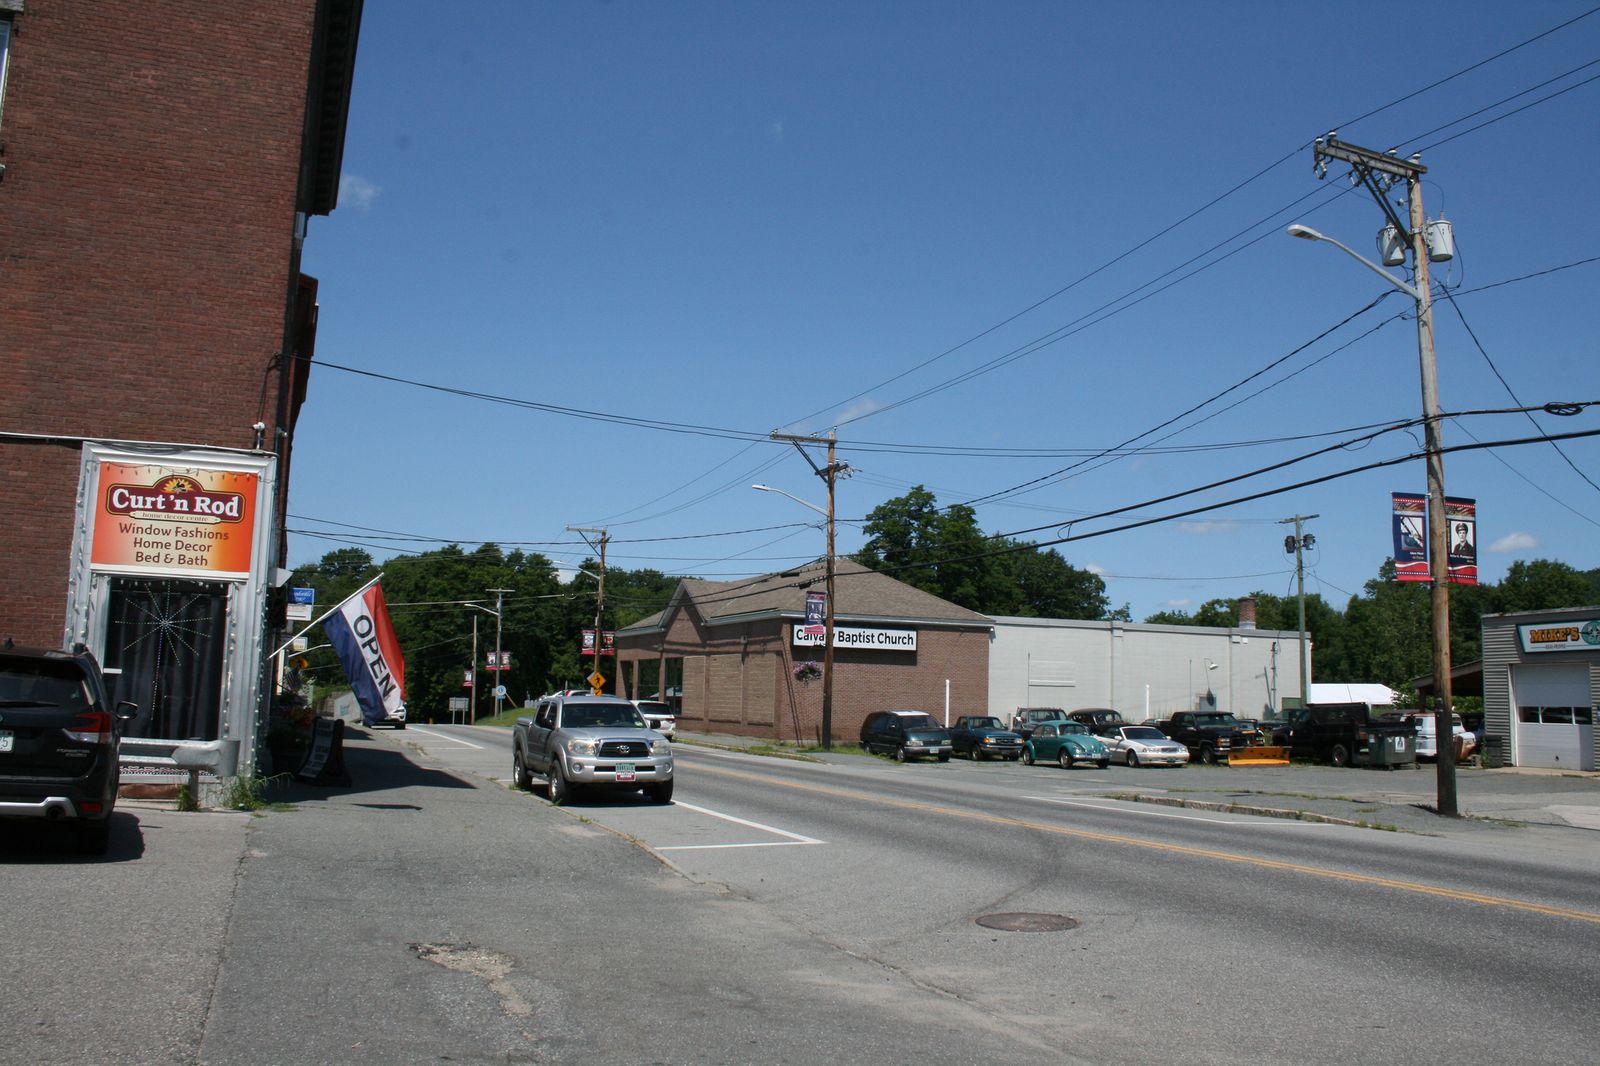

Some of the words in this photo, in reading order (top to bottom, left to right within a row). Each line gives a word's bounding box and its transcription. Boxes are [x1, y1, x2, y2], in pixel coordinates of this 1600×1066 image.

[112, 488, 165, 509] Curt
[193, 495, 239, 517] Rod
[119, 522, 172, 536] Window
[174, 526, 230, 541] Fashions
[133, 537, 172, 550] Home
[174, 540, 213, 553] Decor
[135, 551, 161, 564] Bed
[163, 553, 174, 564] &
[177, 554, 208, 567] Bath
[796, 629, 835, 642] Calva
[838, 630, 875, 646] Baptist
[877, 632, 914, 646] Church
[1530, 627, 1580, 643] MIKE'S
[353, 614, 397, 699] OPEN
